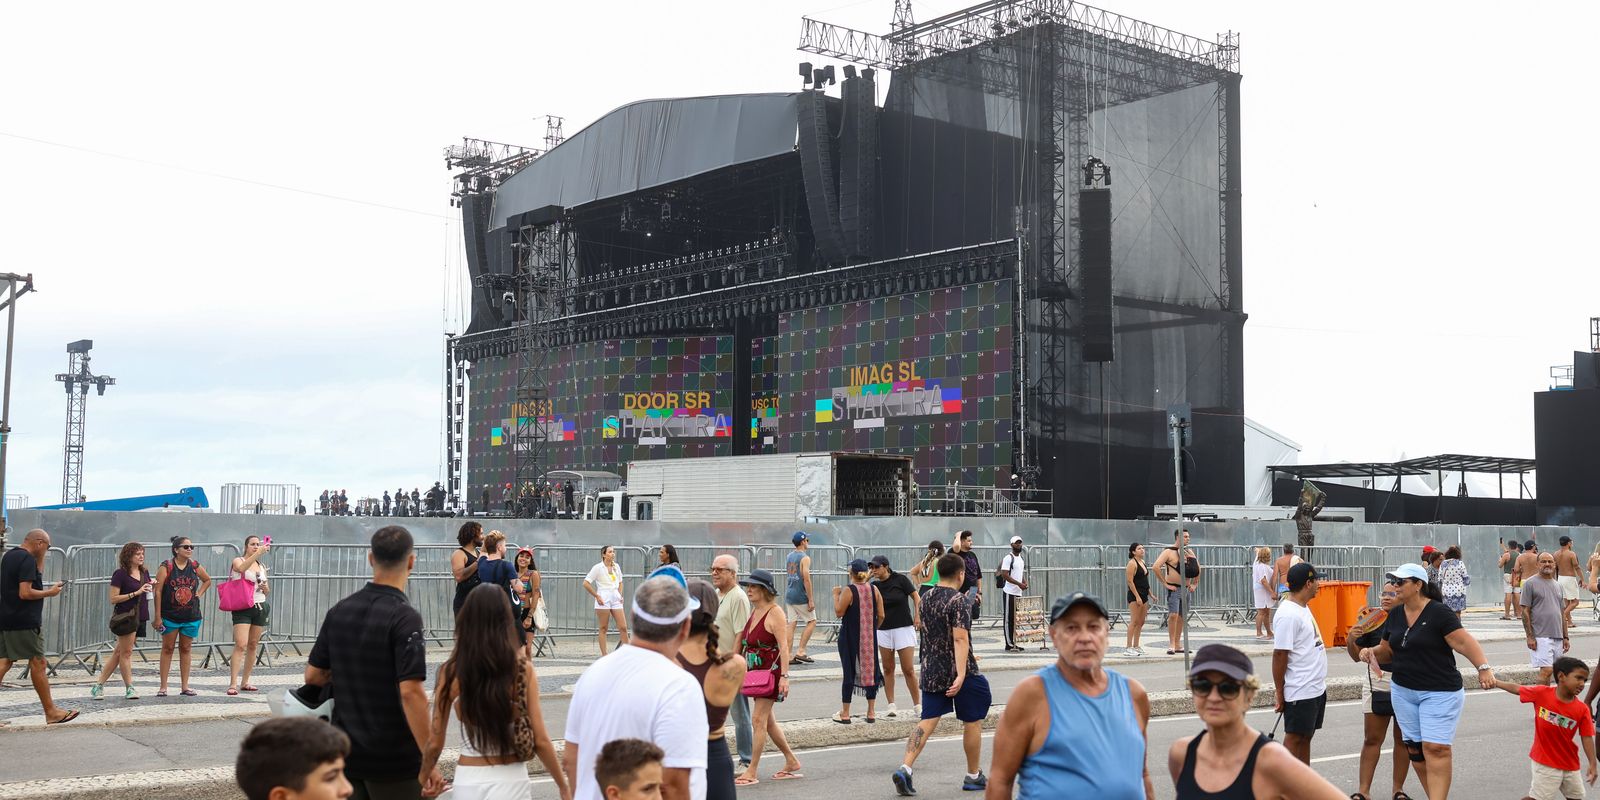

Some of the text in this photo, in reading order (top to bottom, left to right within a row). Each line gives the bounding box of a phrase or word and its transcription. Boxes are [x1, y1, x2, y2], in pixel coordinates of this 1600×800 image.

[850, 363, 893, 386] IMAG
[898, 361, 921, 382] SL
[624, 392, 711, 409] DOOR SR
[751, 398, 769, 410] USC
[832, 385, 943, 421] SHAKIRA
[605, 413, 729, 438] SHAKIRA
